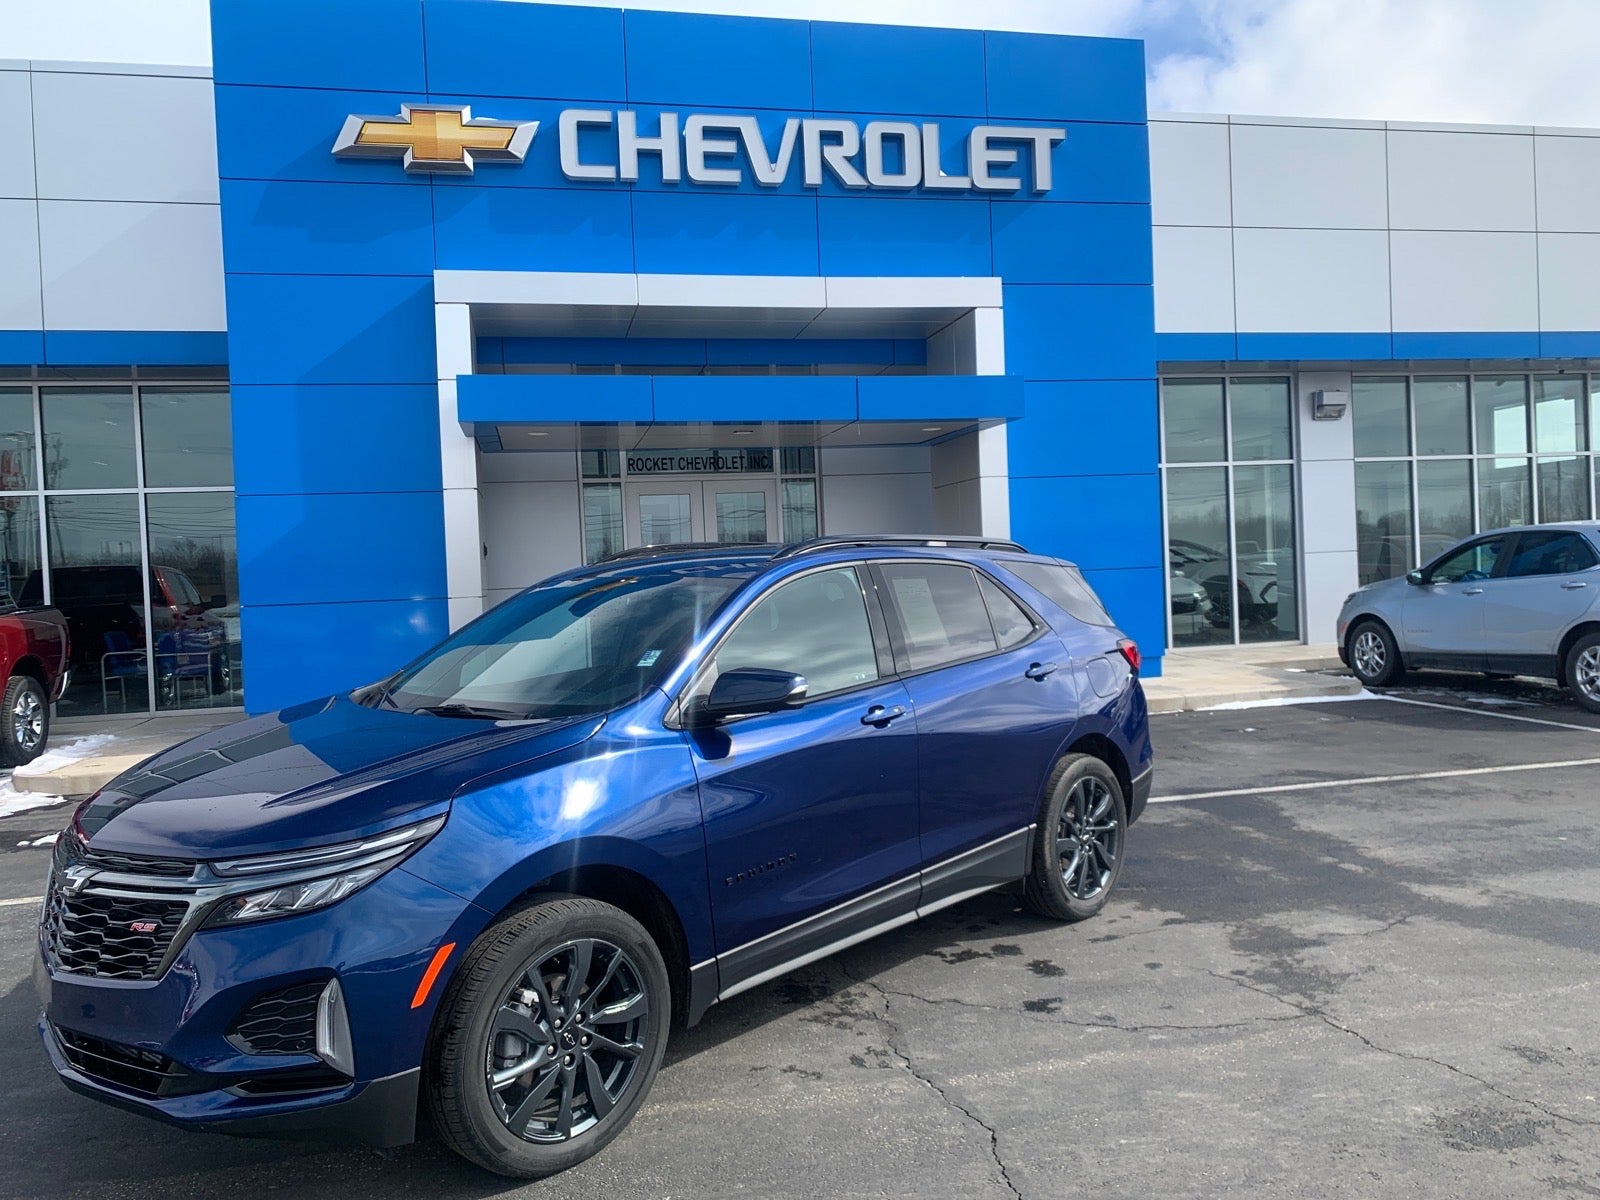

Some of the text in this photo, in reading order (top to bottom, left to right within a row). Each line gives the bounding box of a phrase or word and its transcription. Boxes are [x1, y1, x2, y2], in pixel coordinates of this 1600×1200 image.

[558, 108, 1066, 193] CHEVROLET
[628, 457, 674, 472] ROCKET
[130, 922, 157, 932] RS
